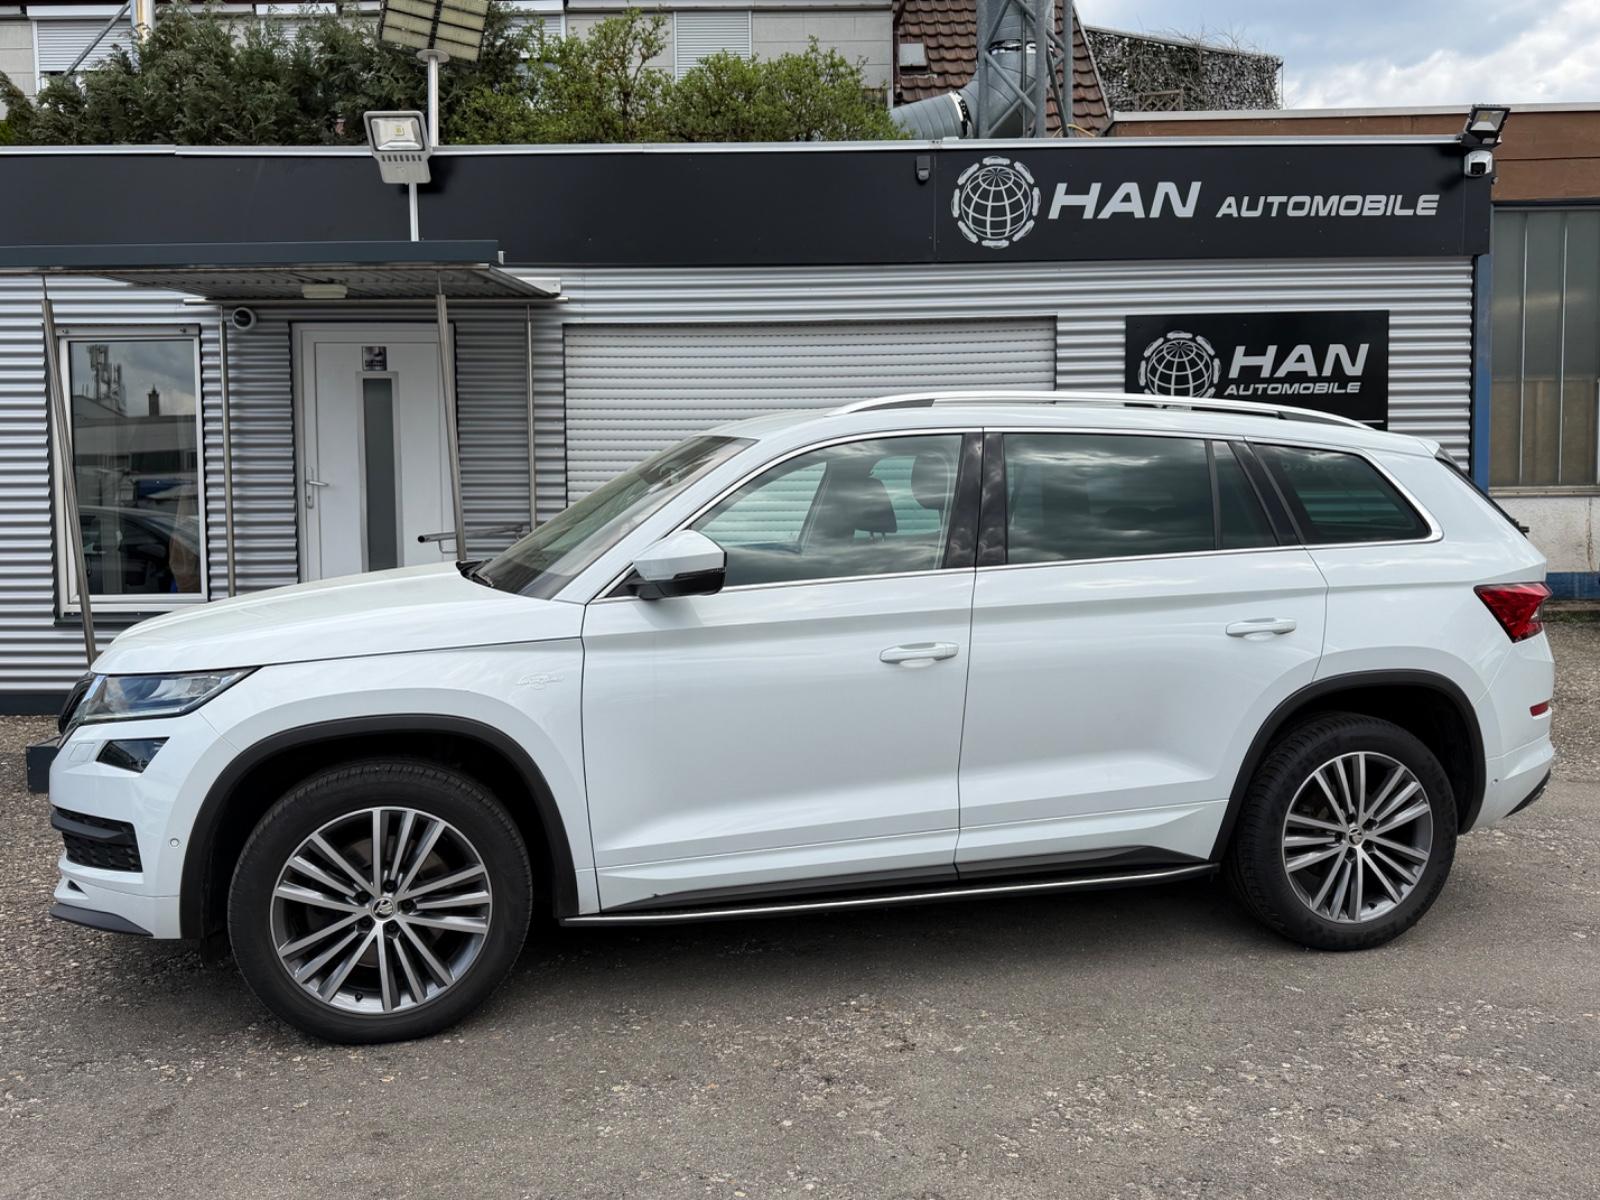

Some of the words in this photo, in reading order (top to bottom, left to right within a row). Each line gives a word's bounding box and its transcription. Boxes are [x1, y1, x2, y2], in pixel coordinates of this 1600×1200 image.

[1047, 181, 1202, 220] HAN
[1215, 194, 1441, 218] AUTOMOBILE
[1228, 343, 1370, 379] HAN
[1223, 382, 1362, 396] AUTOMOBILE
